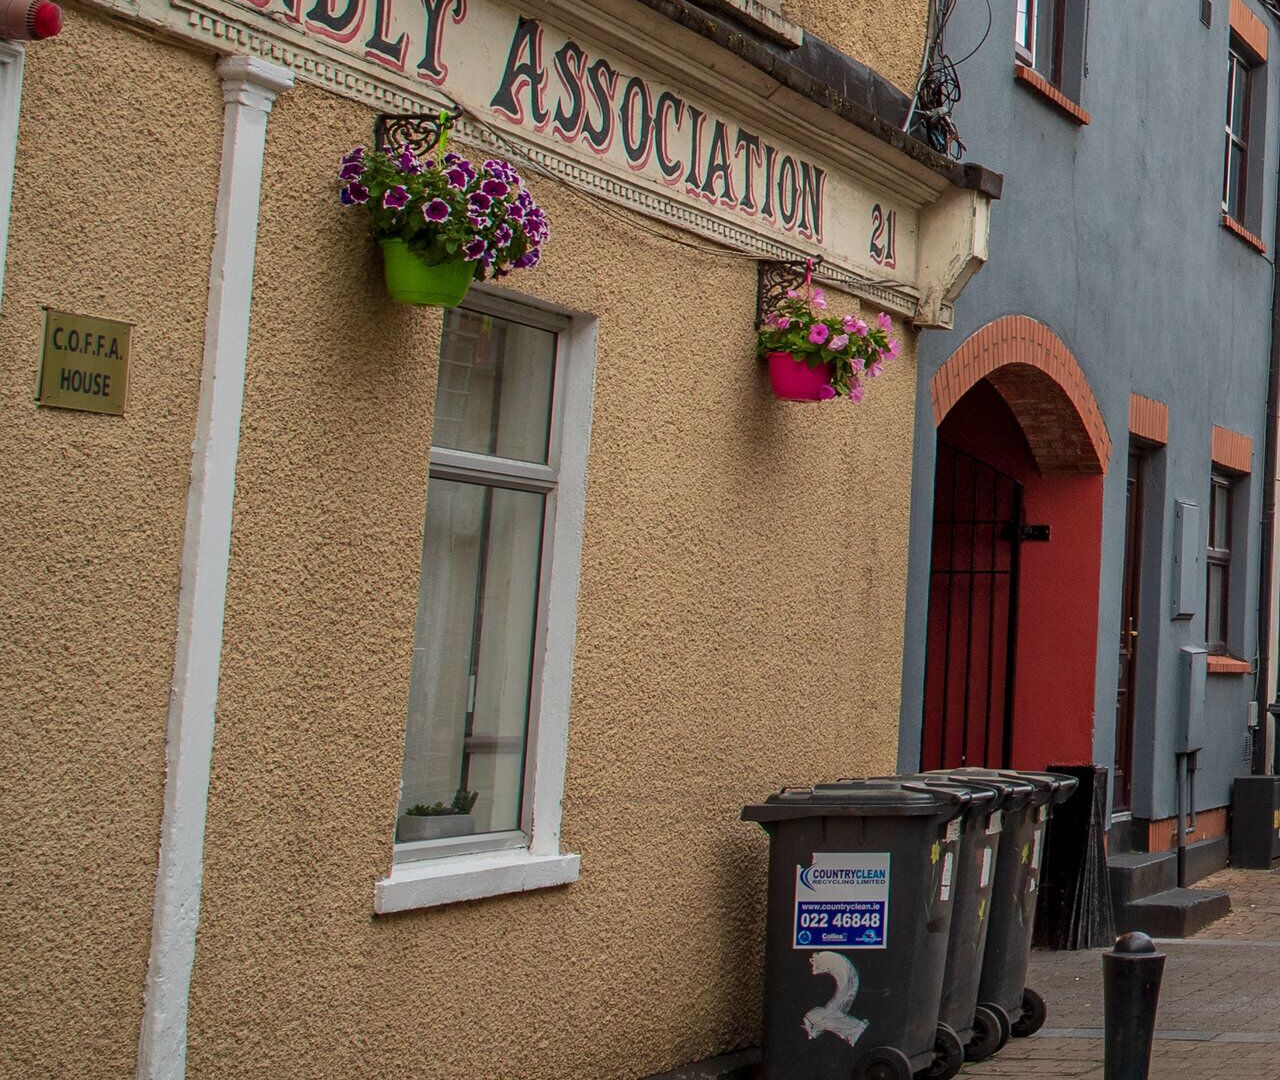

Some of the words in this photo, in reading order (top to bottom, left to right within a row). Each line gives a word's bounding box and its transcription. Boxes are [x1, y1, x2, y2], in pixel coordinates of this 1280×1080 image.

[490, 16, 826, 242] ASSOCIATION
[870, 204, 896, 269] 21
[53, 327, 123, 360] C.O.F.F.A.
[60, 368, 111, 397] HOUSE
[813, 869, 886, 879] COUNTRYCLEAN
[800, 912, 828, 928] 022
[832, 912, 880, 928] 46848
[801, 903, 880, 911] www.countryclean.ie
[800, 951, 870, 1047] 2
